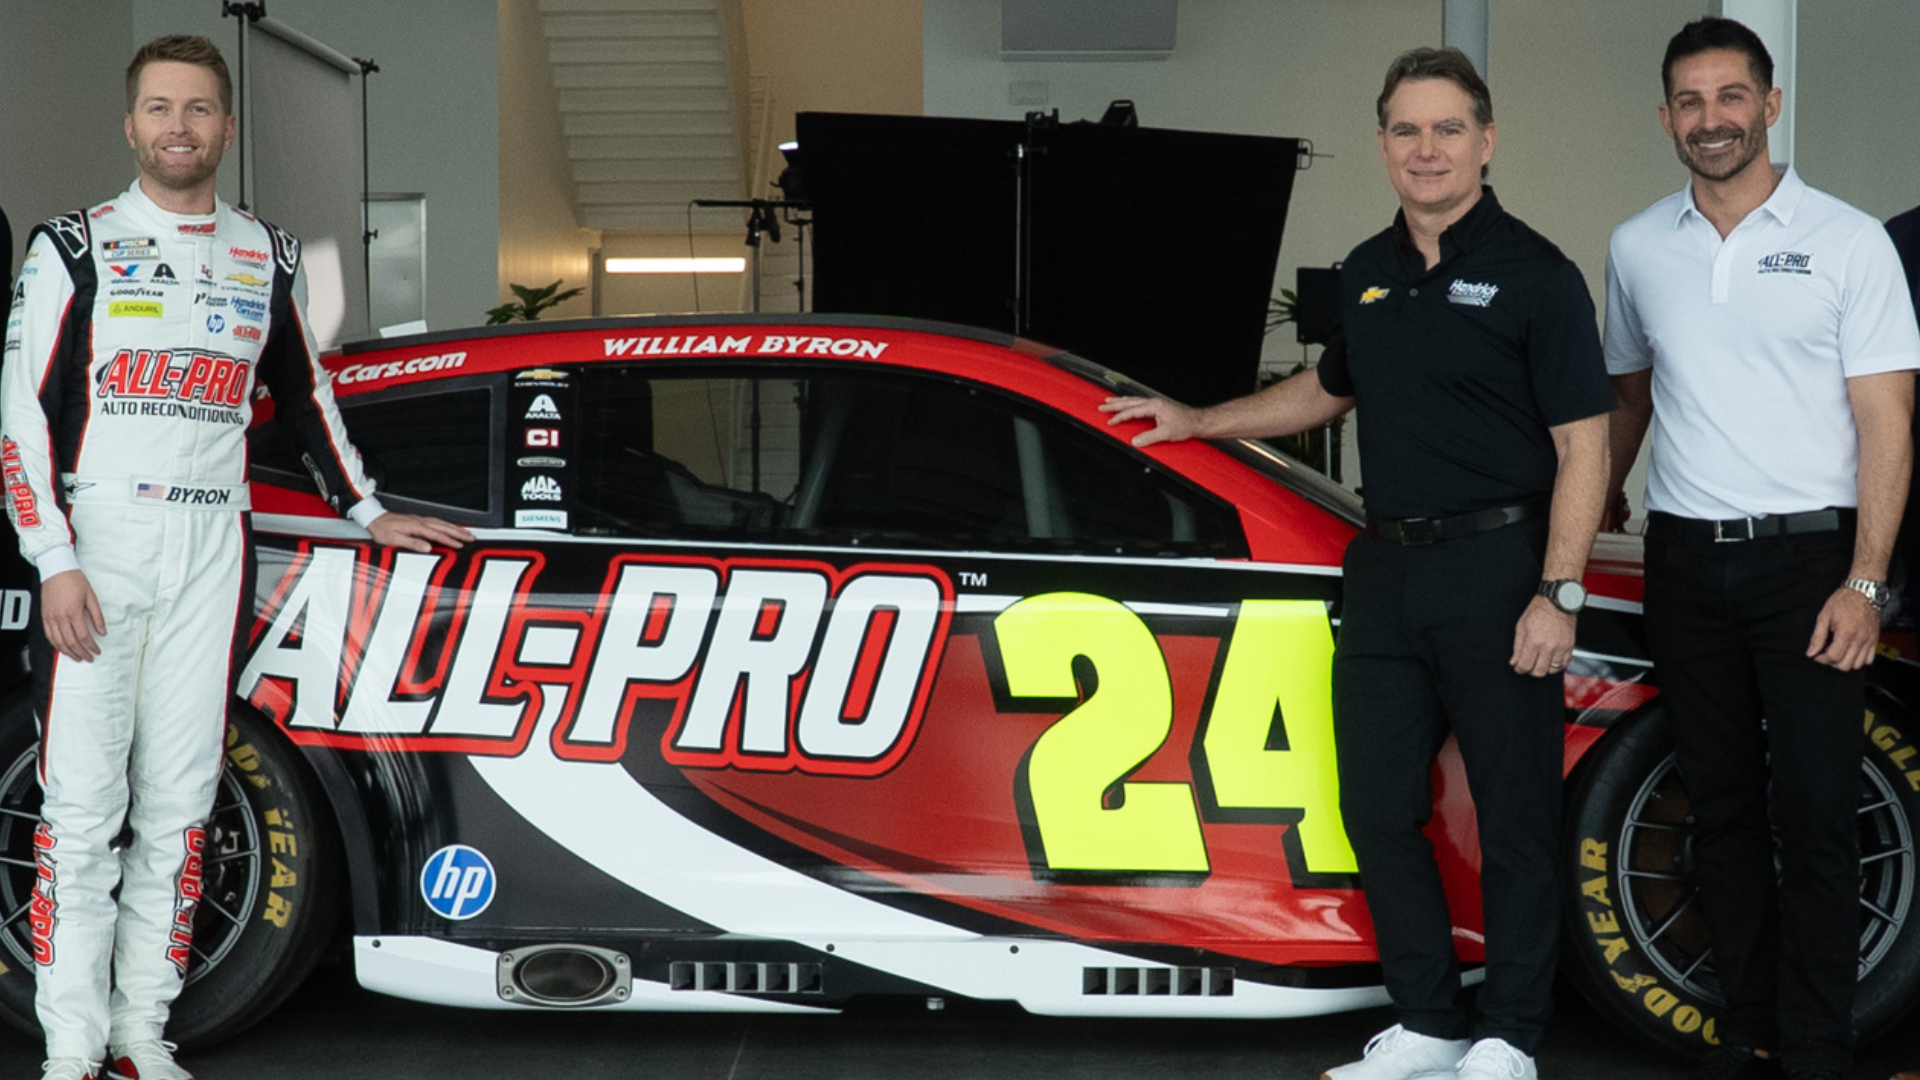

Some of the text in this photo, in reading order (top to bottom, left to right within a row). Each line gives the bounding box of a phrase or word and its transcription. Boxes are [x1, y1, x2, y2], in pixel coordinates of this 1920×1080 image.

[1758, 253, 1810, 268] ALL-PRO
[206, 314, 225, 333] hp
[603, 336, 889, 359] WILLIAM BYRON
[98, 349, 249, 408] ALL-PRO
[326, 352, 467, 385] Cars.com
[101, 402, 244, 425] AUTO RECONDITIONING
[524, 412, 561, 420] AXALTA
[526, 429, 560, 447] CI
[165, 486, 231, 504] BYRON
[521, 475, 562, 494] MAC
[521, 493, 562, 501] TOOLS
[521, 514, 562, 524] SIEMENS
[959, 573, 987, 587] TM
[0, 590, 31, 630] D
[233, 543, 945, 762] ALL-PRO
[994, 592, 1359, 873] 24
[262, 808, 298, 929] YEAR
[430, 846, 488, 918] hp
[1580, 837, 1630, 965] YEAR
